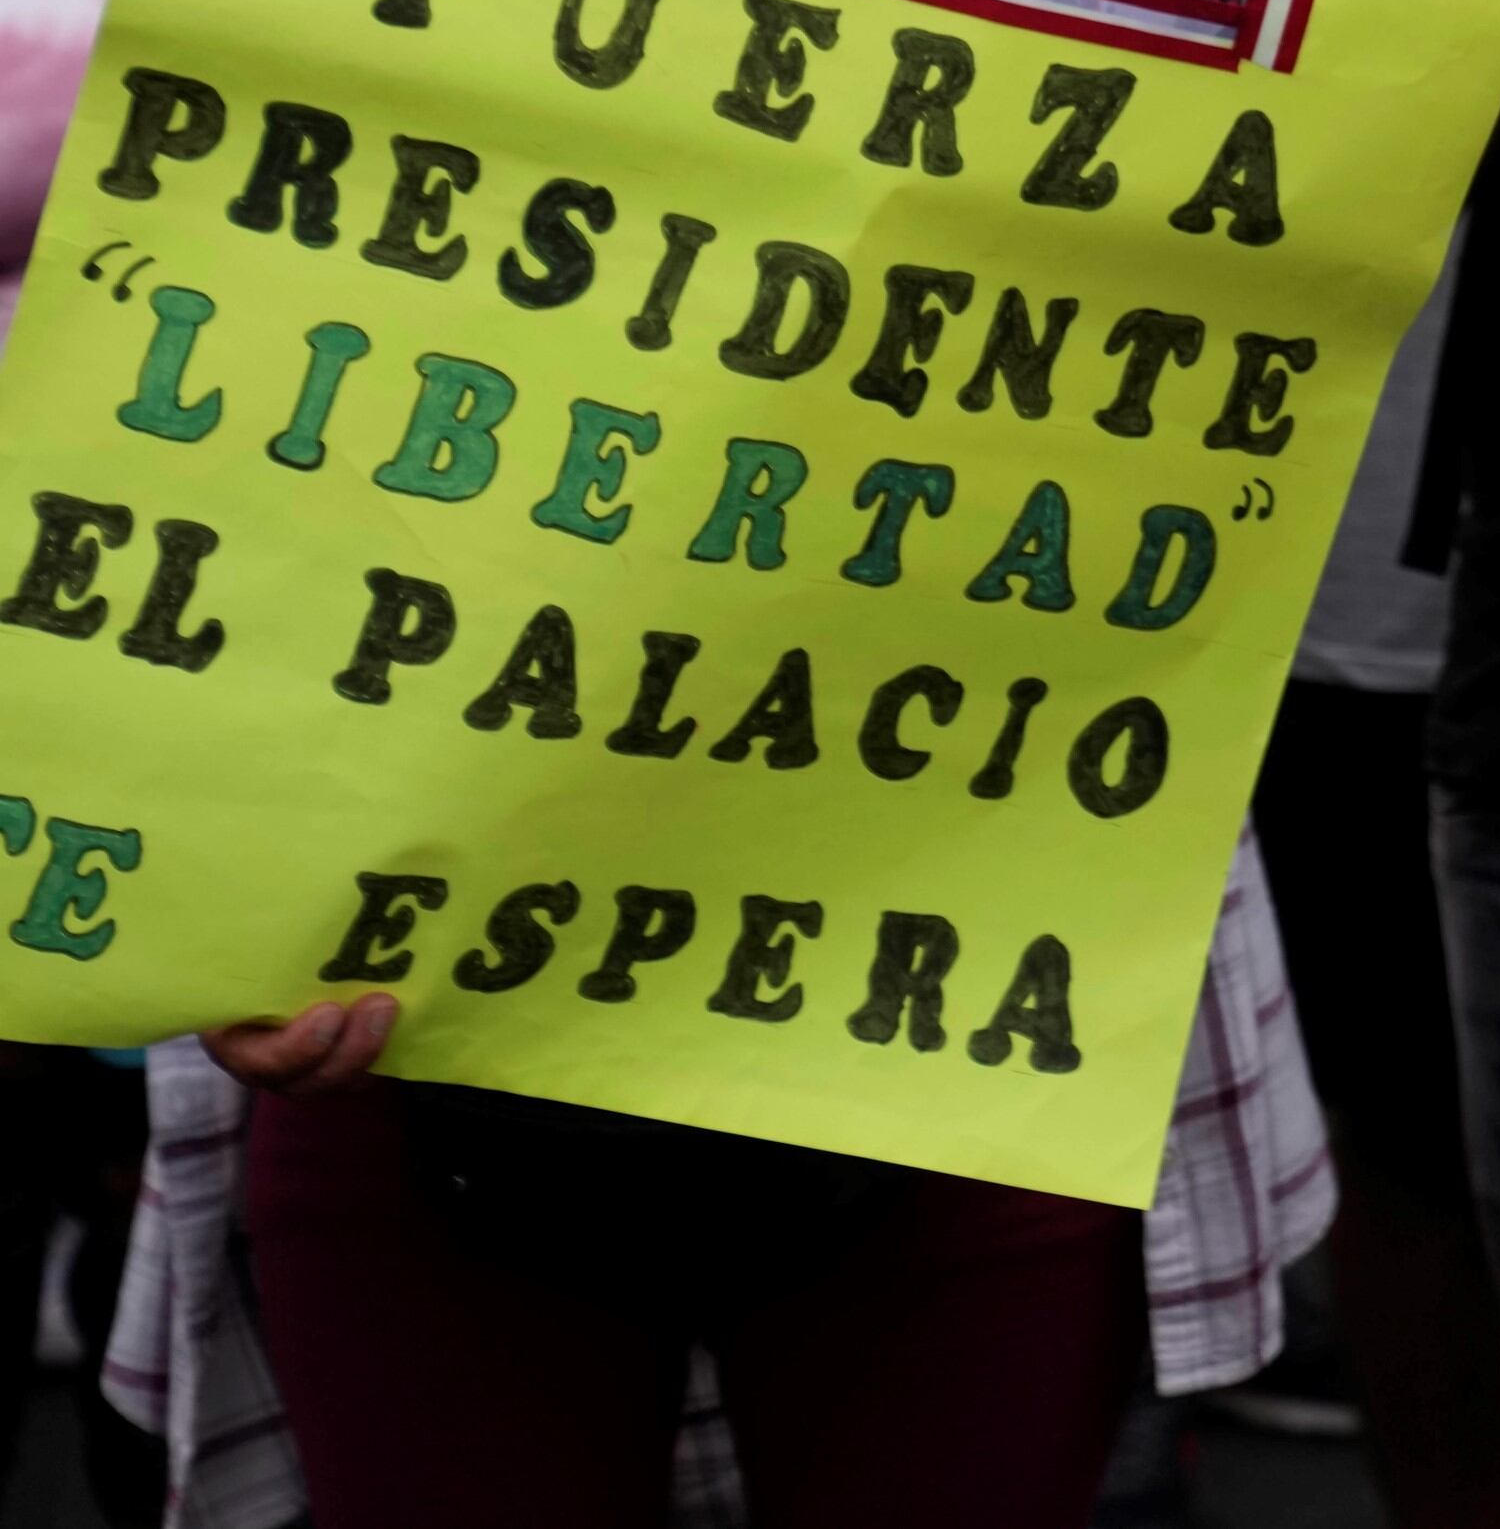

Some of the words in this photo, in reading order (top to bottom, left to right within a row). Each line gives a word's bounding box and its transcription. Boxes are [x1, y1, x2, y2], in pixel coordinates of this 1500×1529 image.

[97, 67, 1316, 456] PRESIDENTE
[0, 491, 226, 673] EL
[332, 567, 1169, 819] PALACIO
[319, 871, 1081, 1074] ESPERA
